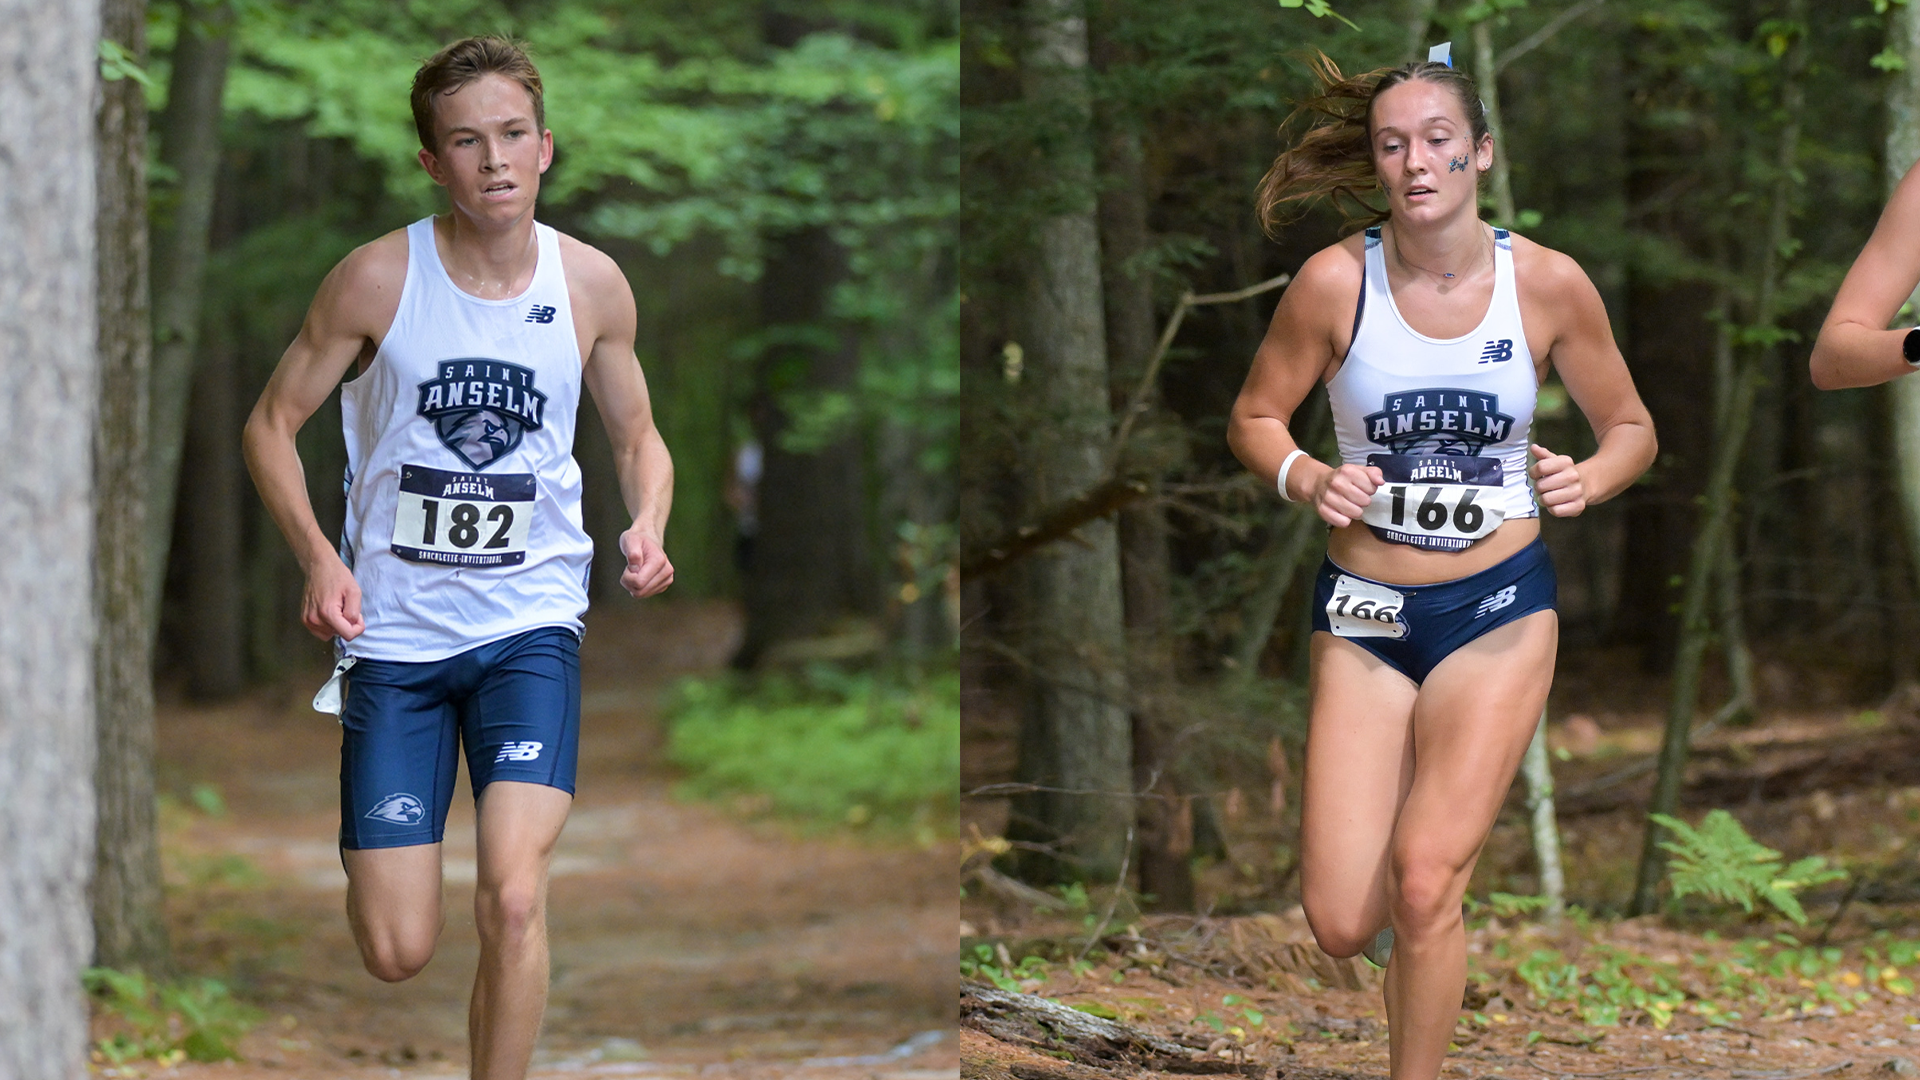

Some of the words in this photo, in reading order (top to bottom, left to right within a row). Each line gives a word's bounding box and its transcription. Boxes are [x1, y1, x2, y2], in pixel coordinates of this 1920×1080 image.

[524, 304, 556, 324] NB
[1478, 338, 1514, 364] NB
[445, 364, 528, 386] SAINT
[423, 381, 540, 425] ANSELM
[1391, 394, 1489, 412] SAINT
[1373, 410, 1506, 440] ANSELM
[1410, 465, 1463, 483] ANSELM
[1418, 458, 1456, 468] SAINT
[442, 482, 495, 501] ANSELM
[452, 475, 489, 485] SAINT
[1389, 486, 1484, 534] 166
[422, 498, 514, 550] 182
[1335, 594, 1399, 624] 166
[1474, 584, 1518, 620] NB
[494, 740, 543, 764] NB
